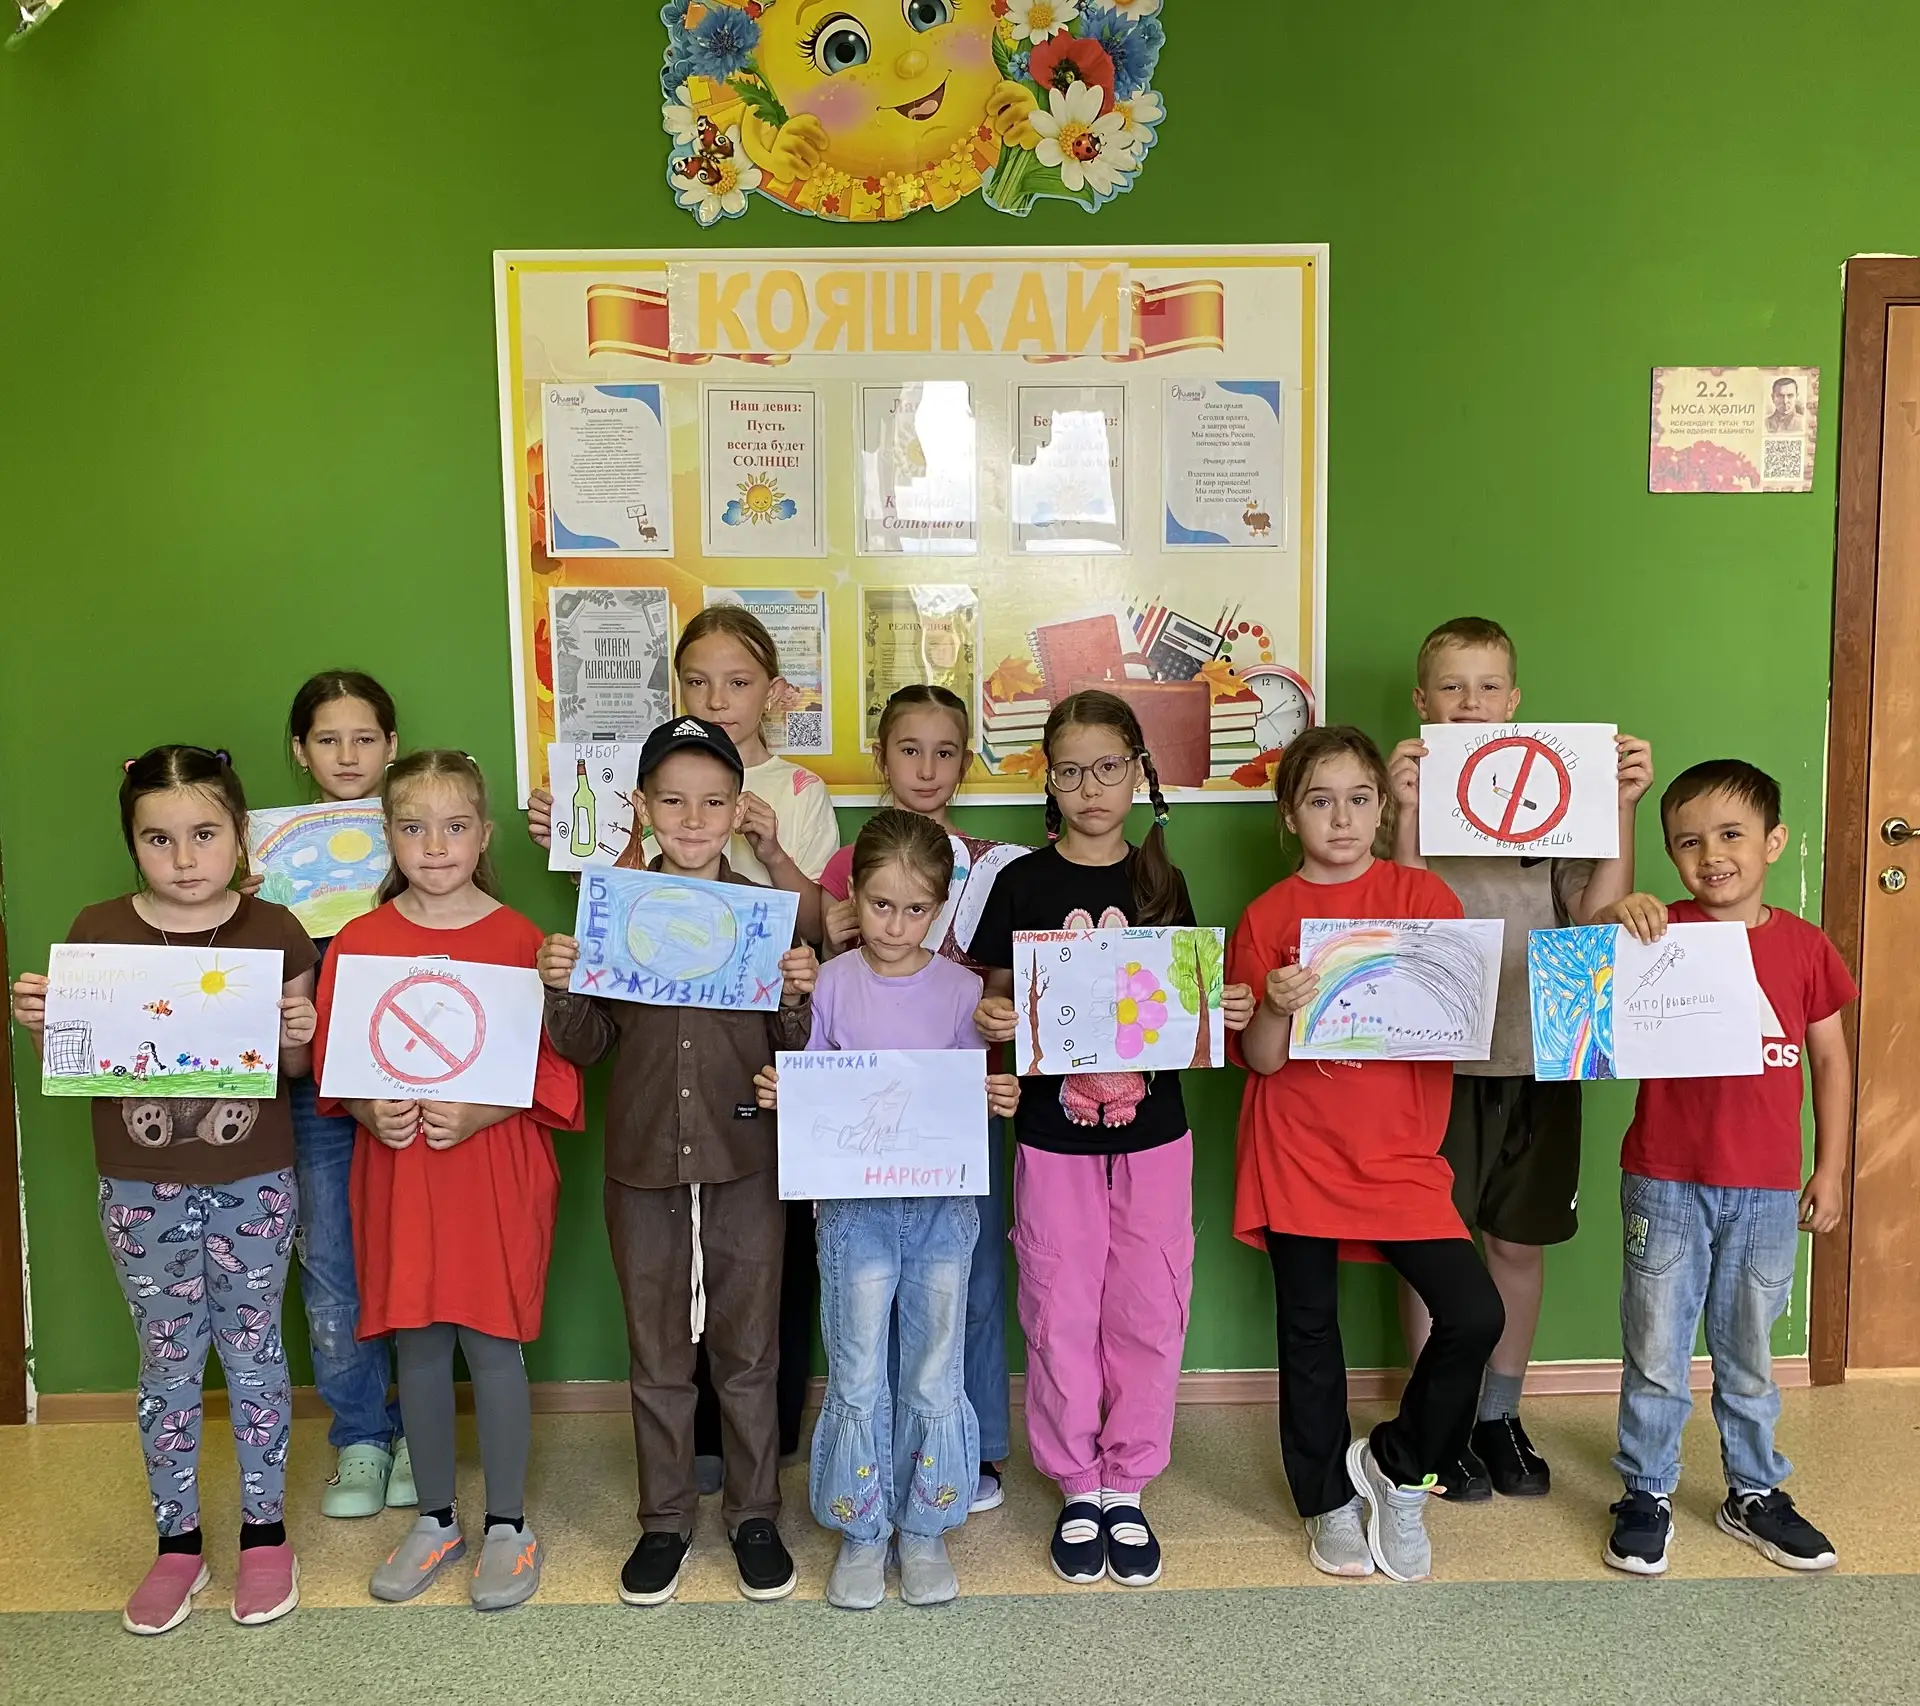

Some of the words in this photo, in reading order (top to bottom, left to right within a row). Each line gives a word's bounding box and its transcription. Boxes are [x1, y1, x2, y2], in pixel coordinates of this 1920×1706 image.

[699, 260, 1121, 352] КОЯШКАЙ
[1696, 381, 1734, 398] 2.2.
[730, 400, 759, 411] Наш
[762, 403, 802, 413] девиз:
[1670, 404, 1705, 414] МУСА
[1708, 404, 1755, 417] ҖӘЛИЛ
[747, 420, 786, 434] Пусть
[727, 441, 767, 451] всегда
[771, 440, 805, 453] будет
[733, 455, 799, 469] СОЛНЦЕ!
[594, 638, 630, 657] ЧИТАЕМ
[585, 660, 642, 679] КЛАССИКОВ
[672, 729, 709, 738] adidas
[608, 966, 736, 1007] ЖИЗНЬ
[54, 987, 114, 1003] ЖИЗНЬ!
[783, 1053, 878, 1070] УНИЧТОЖАЙ
